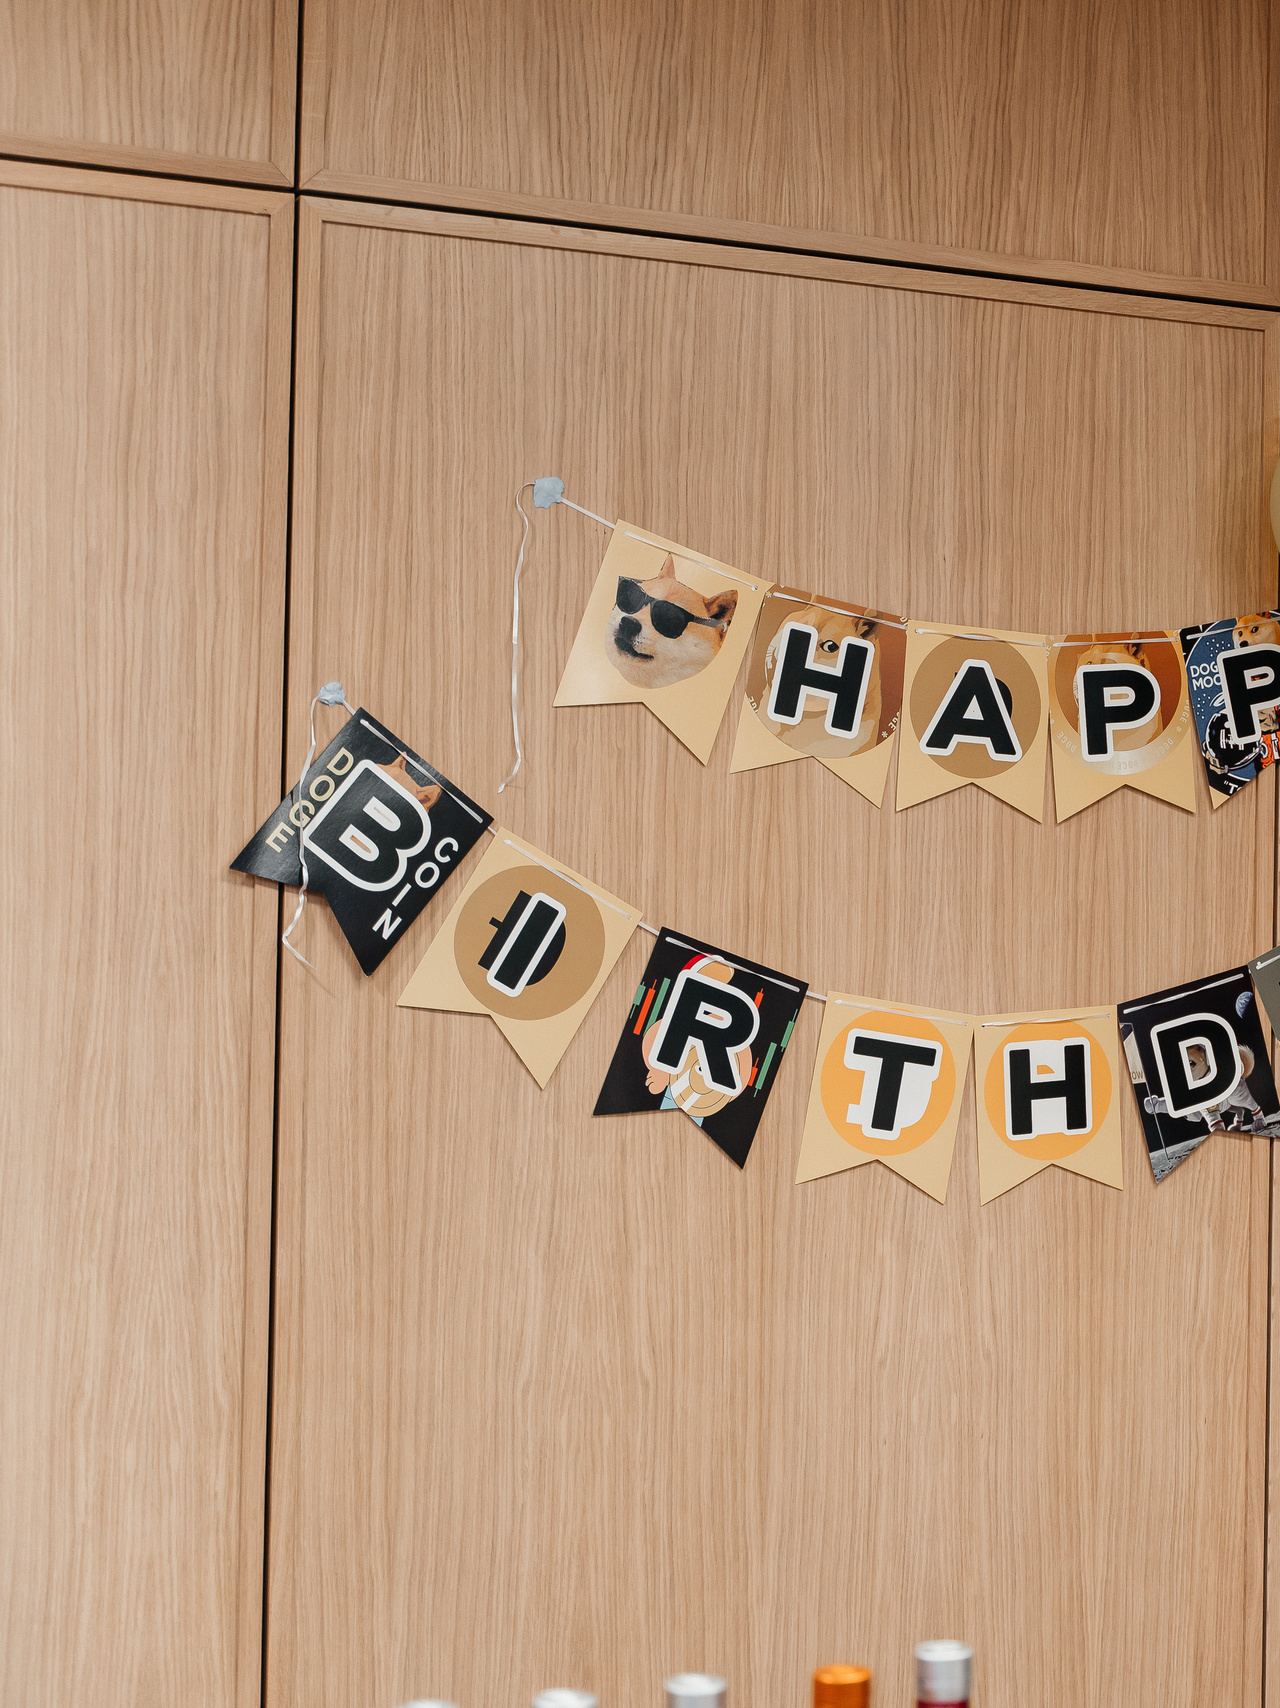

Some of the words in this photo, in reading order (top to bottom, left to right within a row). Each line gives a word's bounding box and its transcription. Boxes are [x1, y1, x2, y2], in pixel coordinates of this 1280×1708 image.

[1190, 661, 1218, 678] DOG
[1192, 674, 1222, 691] MOO
[265, 747, 354, 853] DOGE
[372, 837, 459, 940] COIN
